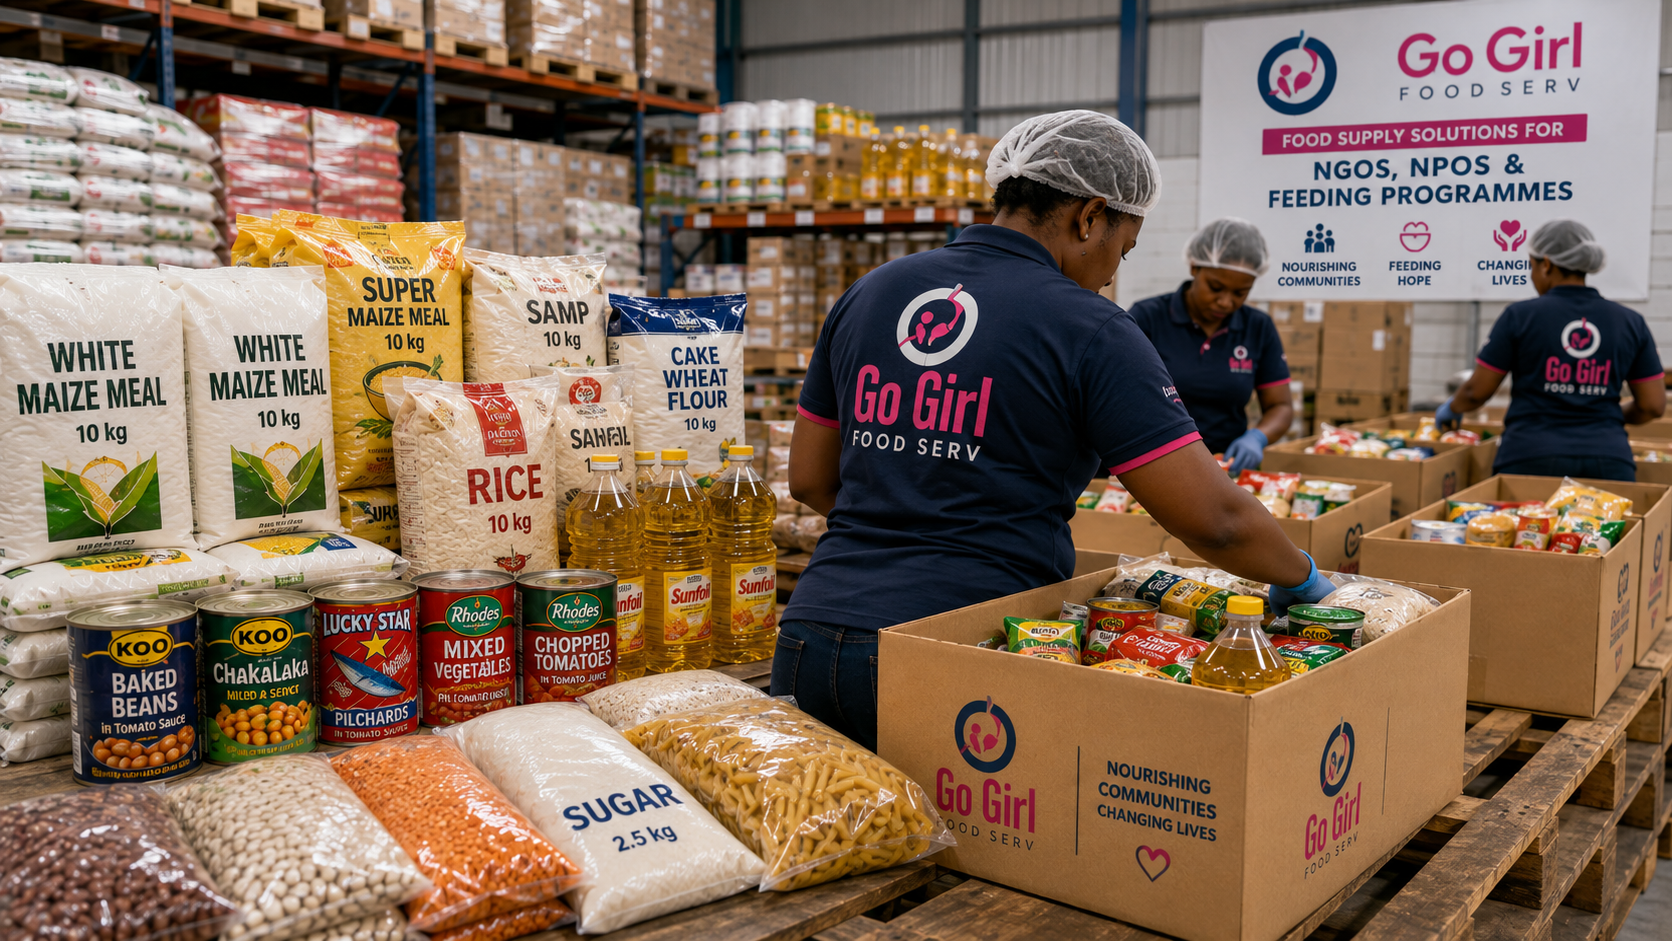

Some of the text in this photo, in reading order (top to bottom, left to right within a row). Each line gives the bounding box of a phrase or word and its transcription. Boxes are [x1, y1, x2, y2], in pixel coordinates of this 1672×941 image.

[1398, 21, 1582, 78] Go Girl
[1399, 77, 1582, 101] FOOD SERV
[1282, 121, 1564, 149] FOOD SUPPLY SOLUTIONS FOR
[1313, 153, 1525, 182] NGOS, NPOS &
[1269, 181, 1573, 209] FEEDING PROGRAMMES
[1281, 261, 1357, 273] NOURISHING
[1388, 260, 1442, 272] FEEDING
[1477, 259, 1532, 272] CHANGI
[362, 276, 437, 303] SUPER
[1277, 275, 1361, 288] COMMUNITIES
[1397, 275, 1432, 287] HOPE
[1491, 274, 1527, 286] LIVES
[347, 307, 450, 327] MAIZE MEAL
[526, 299, 589, 324] SAMP
[233, 334, 306, 363] WHITE
[384, 333, 425, 353] 10 kg
[543, 331, 581, 350] 10 kg
[47, 339, 136, 373] WHITE
[671, 346, 720, 366] CAKE
[662, 368, 728, 389] WHEAT
[1545, 356, 1611, 386] Go Girl
[17, 376, 167, 415] MAIZE MEAL
[209, 368, 327, 401] MAIZE MEAL
[1544, 382, 1608, 396] FOOD SERV
[668, 390, 728, 411] FLOUR
[854, 364, 993, 438] Go Girl
[257, 409, 301, 429] 10 kg
[684, 417, 716, 432] 10 kg
[75, 423, 127, 445] 10 kg
[852, 430, 981, 462] FOOD SERV
[466, 463, 544, 505] RICE
[488, 512, 532, 535] 10 kg
[670, 582, 711, 605] Sunfoil
[738, 574, 775, 595] Sunfoil
[552, 602, 599, 619] Rhodes
[617, 591, 643, 613] unfoil
[323, 608, 412, 638] LUCKY STAR
[451, 605, 500, 624] Rhodes
[116, 638, 169, 657] KOO
[238, 628, 288, 646] KOO
[443, 636, 505, 660] MIXED
[535, 631, 610, 653] CHOPPED
[533, 649, 611, 671] TOMATOES
[111, 668, 177, 694] BAKED
[111, 692, 178, 718] BEANS
[335, 705, 409, 726] PILCHARDS
[1107, 760, 1211, 795] NOURISHING
[563, 783, 684, 831] SUGAR
[936, 767, 1036, 834] Go Girl
[1098, 781, 1217, 819] COMMUNITIES
[1097, 804, 1217, 842] CHANGING LIVES
[1304, 781, 1362, 860] Go Girl
[612, 825, 678, 852] 2.5 kg
[990, 829, 1035, 851] SERV
[1304, 831, 1359, 879] FOOD SERV
